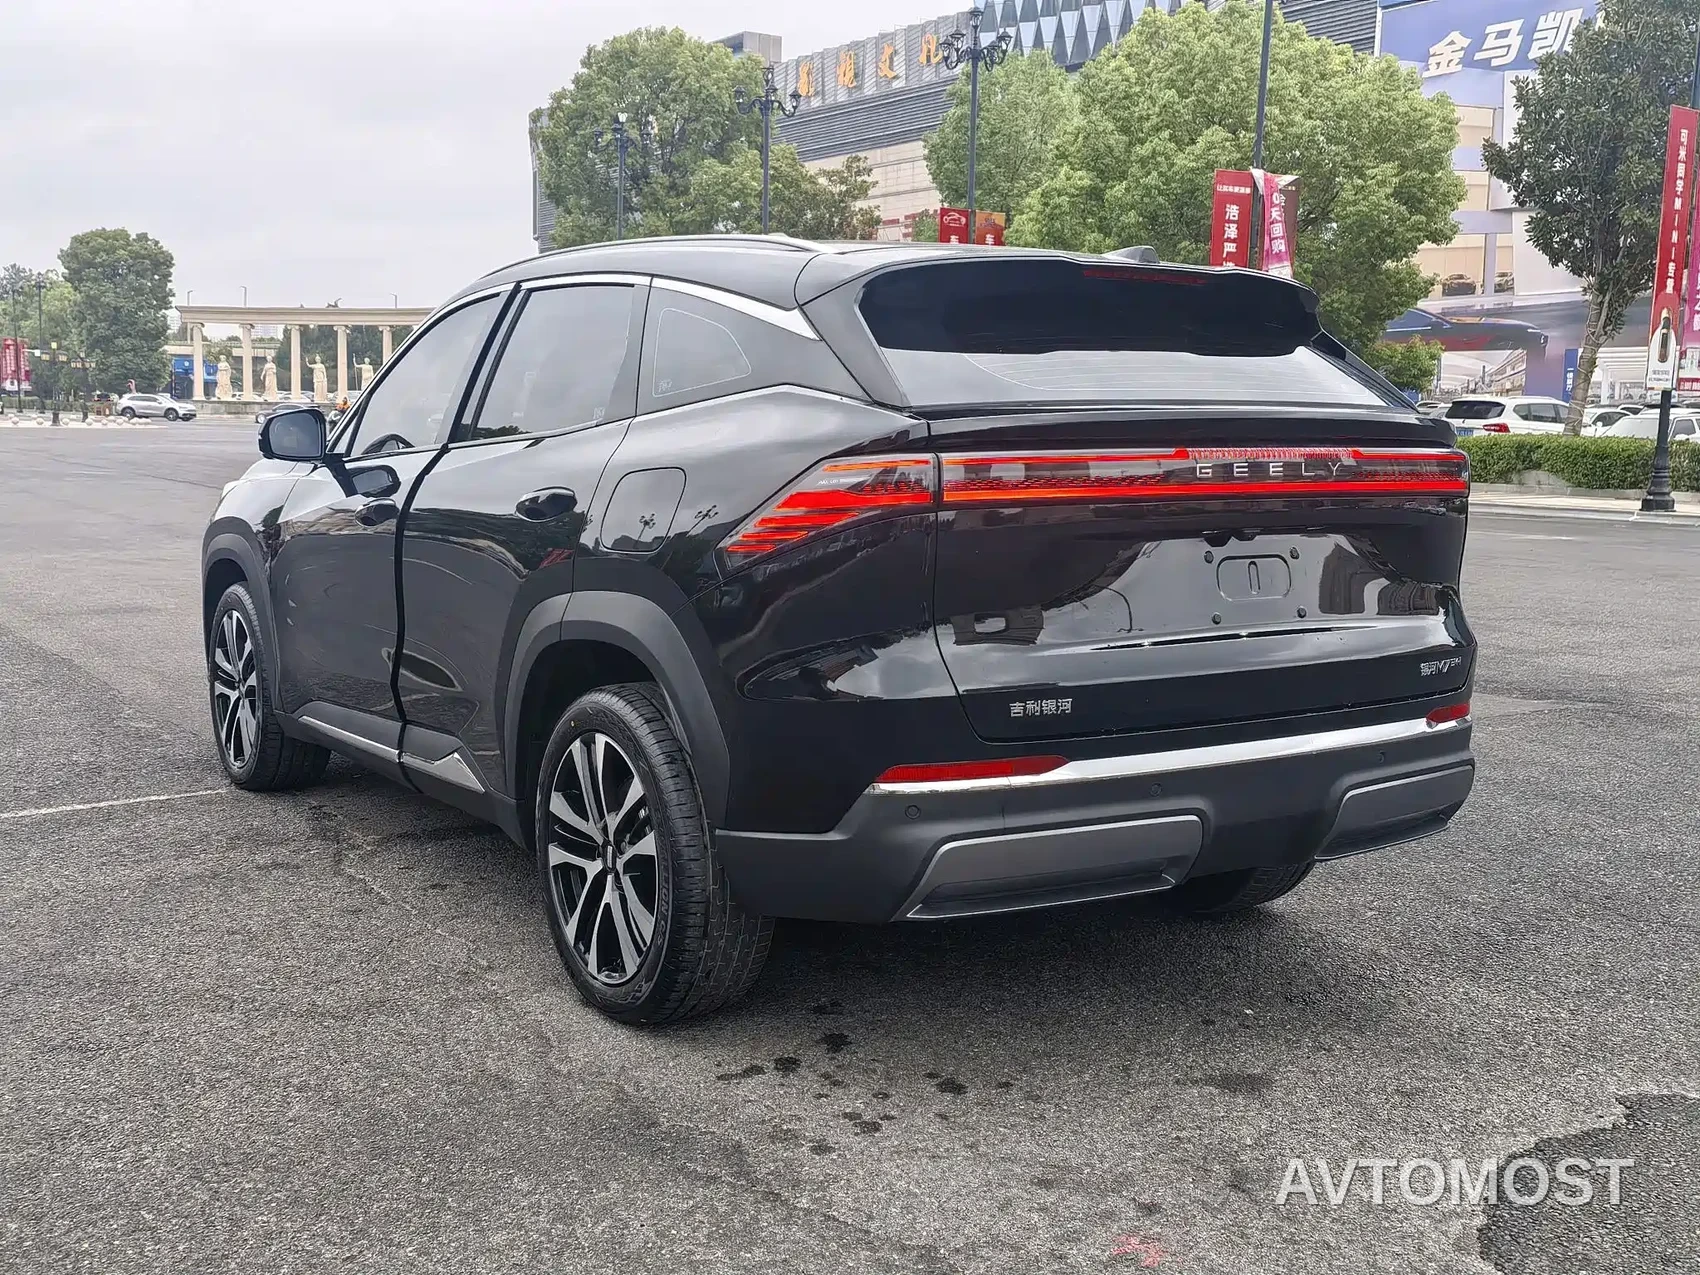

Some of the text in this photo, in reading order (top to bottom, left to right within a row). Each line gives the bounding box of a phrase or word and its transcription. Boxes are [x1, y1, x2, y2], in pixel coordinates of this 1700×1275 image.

[1422, 8, 1606, 78] 金马凯
[1196, 462, 1341, 477] GEELY
[1009, 698, 1073, 717] 吉利银河
